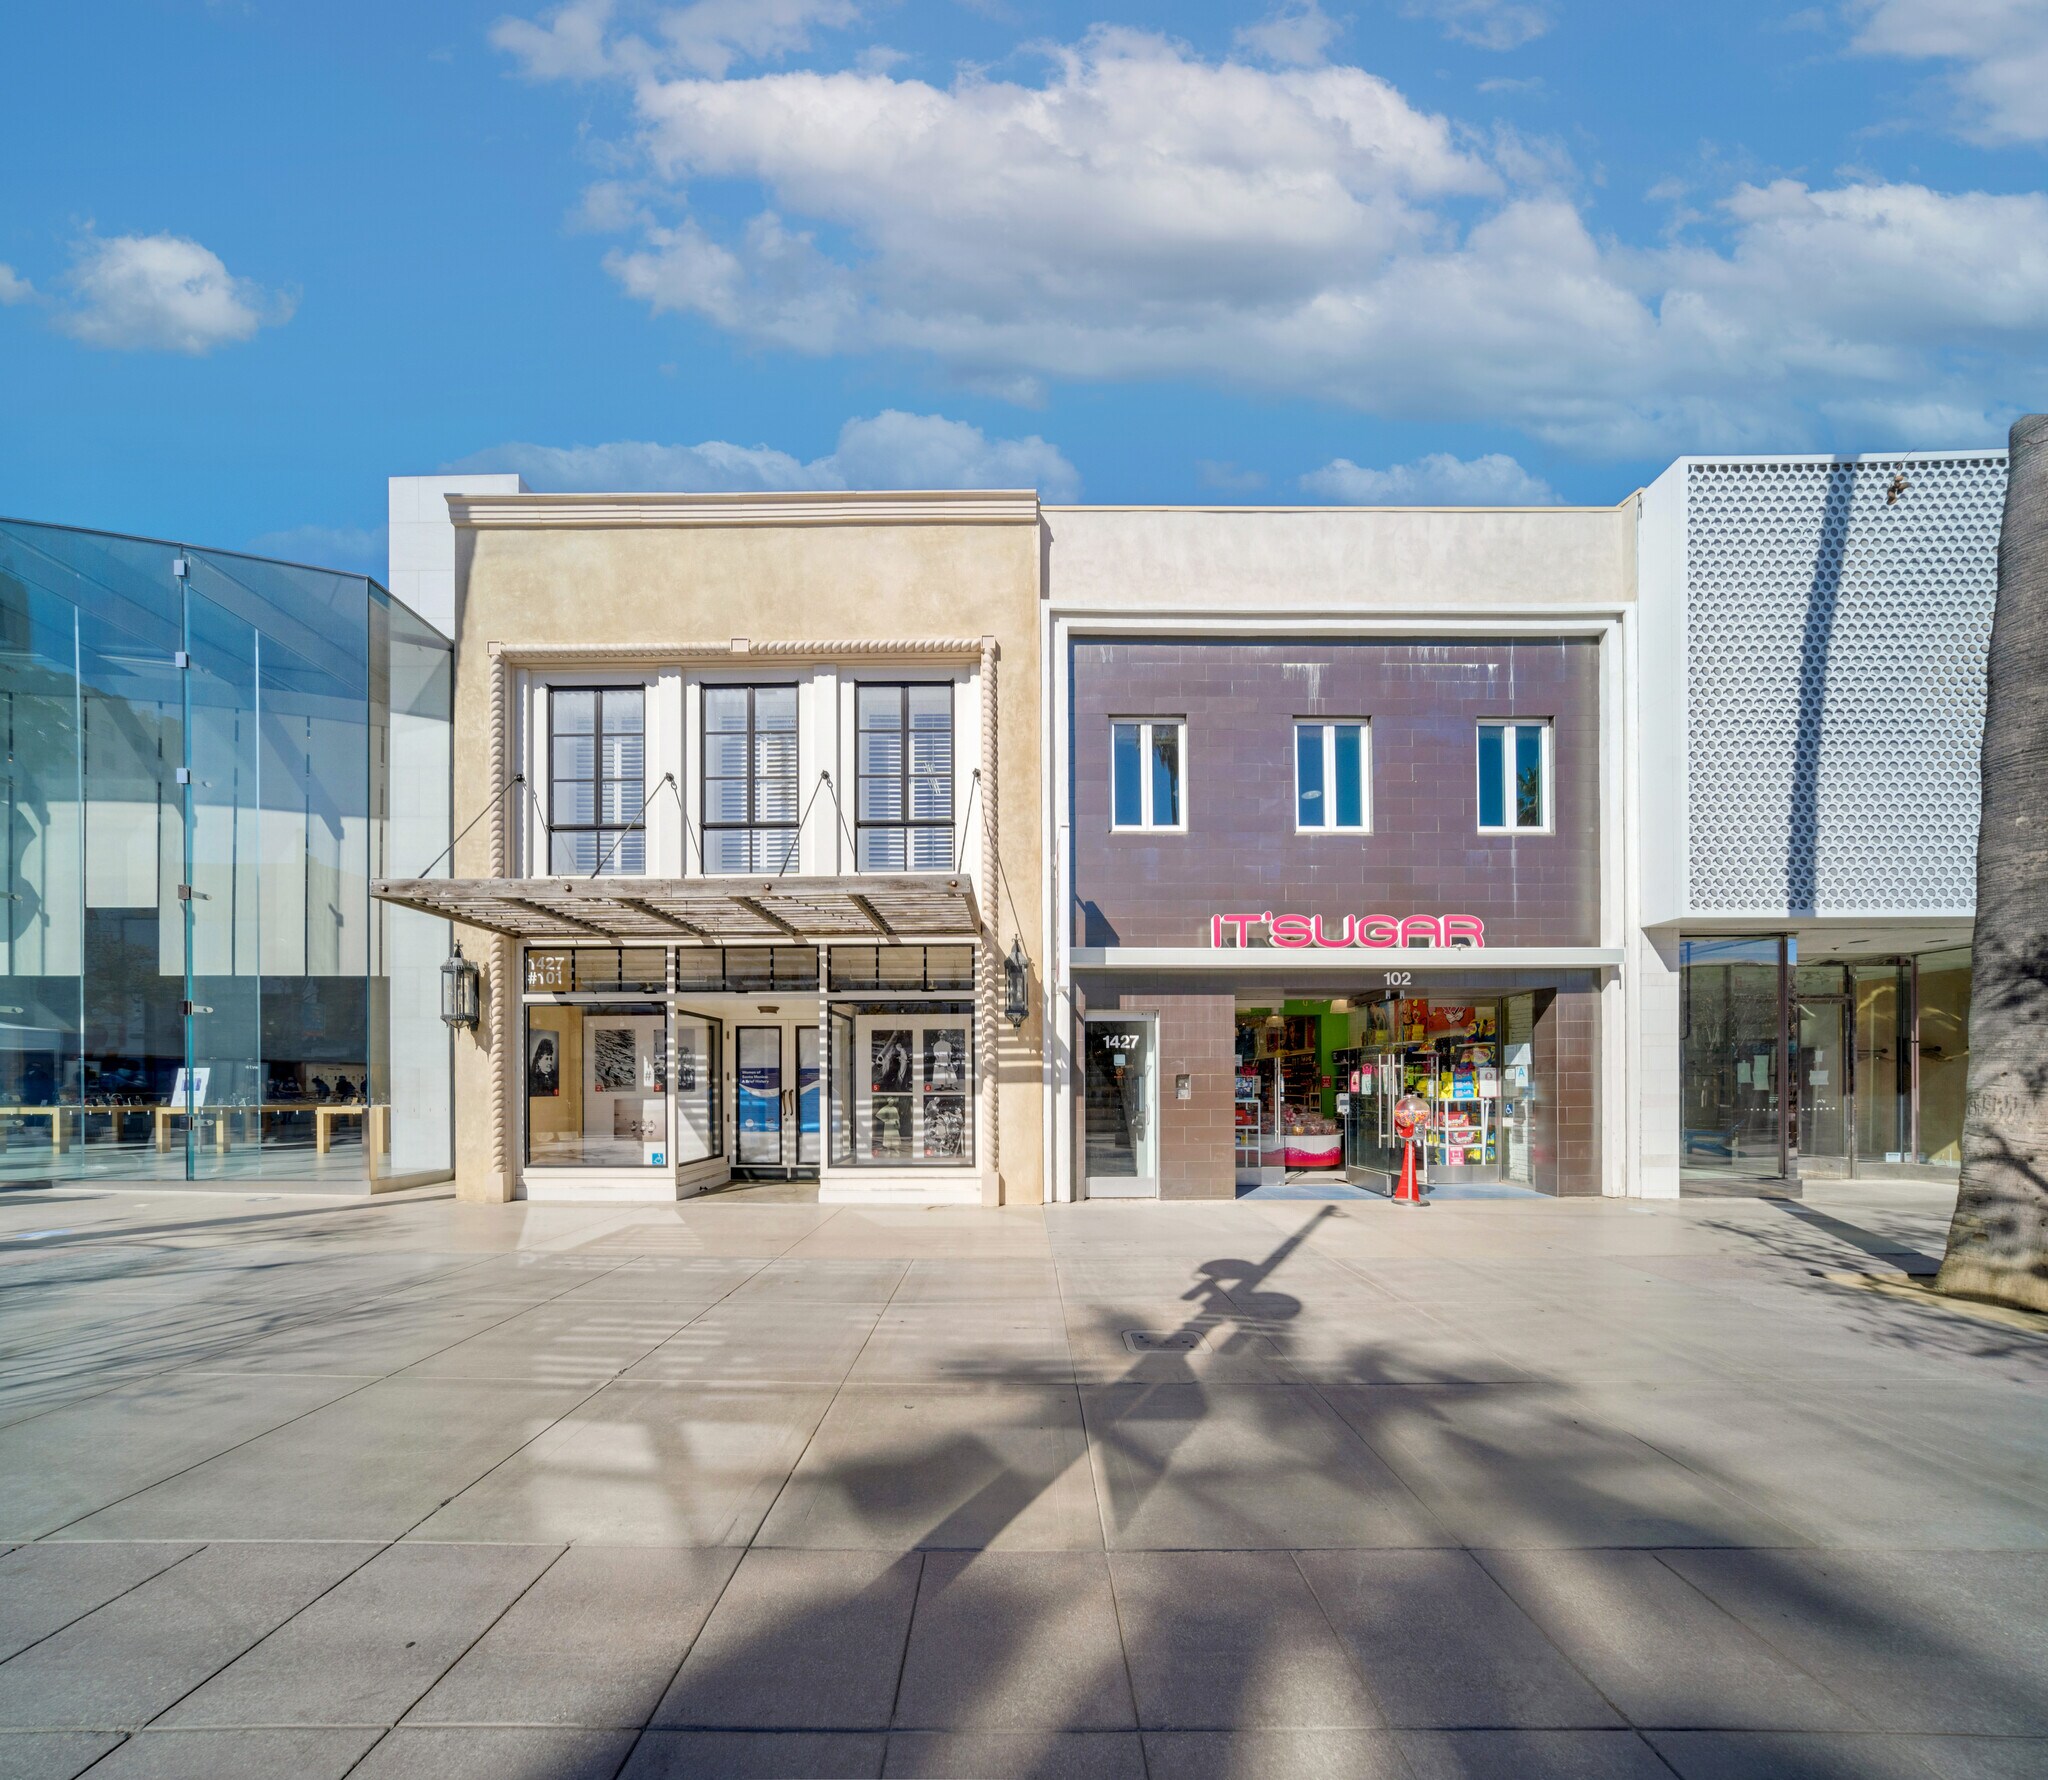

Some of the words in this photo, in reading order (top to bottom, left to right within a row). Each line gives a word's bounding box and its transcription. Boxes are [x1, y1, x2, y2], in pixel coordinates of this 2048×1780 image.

[1212, 911, 1485, 948] IT'SUGAR
[528, 957, 565, 970] 1427
[528, 971, 562, 985] #101
[1384, 972, 1412, 985] 102
[1103, 1035, 1140, 1049] 1427
[1518, 1068, 1525, 1077] A
